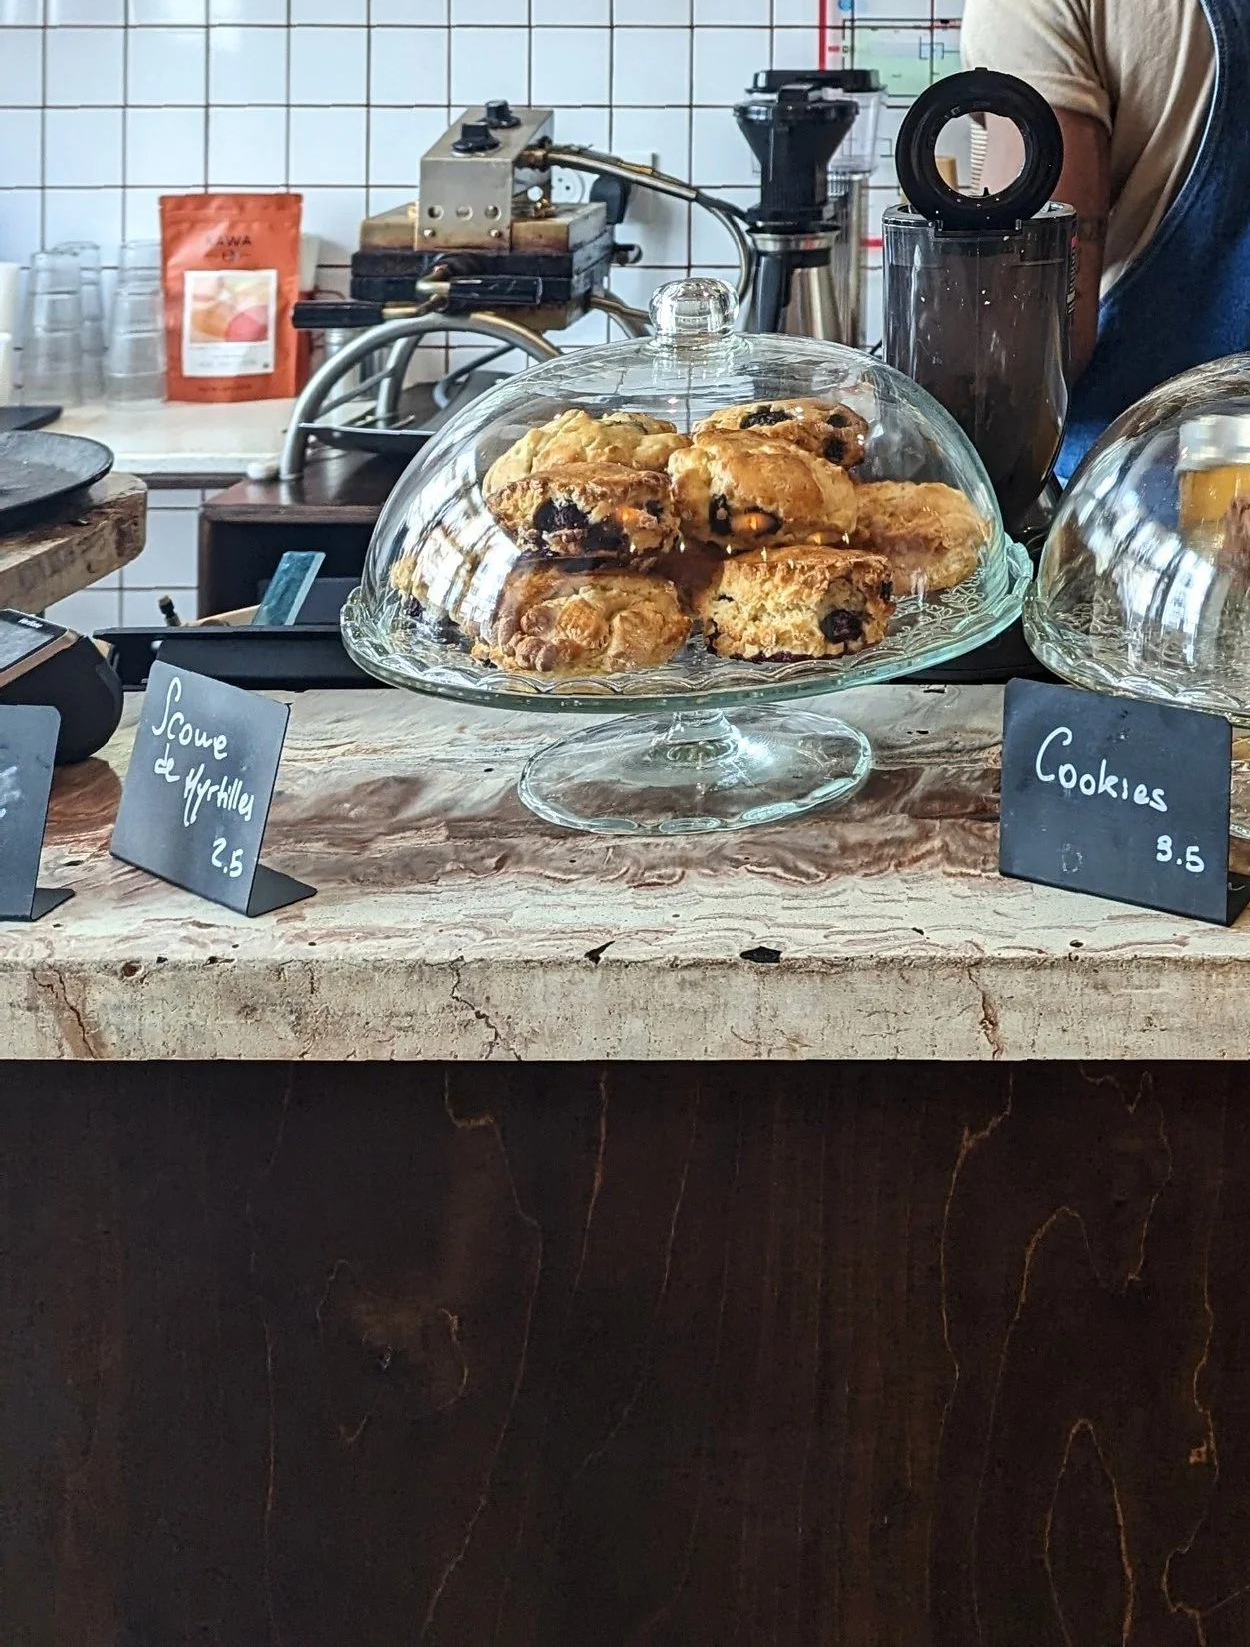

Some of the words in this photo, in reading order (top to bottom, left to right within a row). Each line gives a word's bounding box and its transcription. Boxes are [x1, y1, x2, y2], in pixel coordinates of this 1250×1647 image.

[205, 234, 253, 247] KAWA
[154, 742, 181, 783] de
[1035, 725, 1169, 813] Cookies
[210, 836, 245, 878] 2.5
[1155, 834, 1206, 873] 3.5
